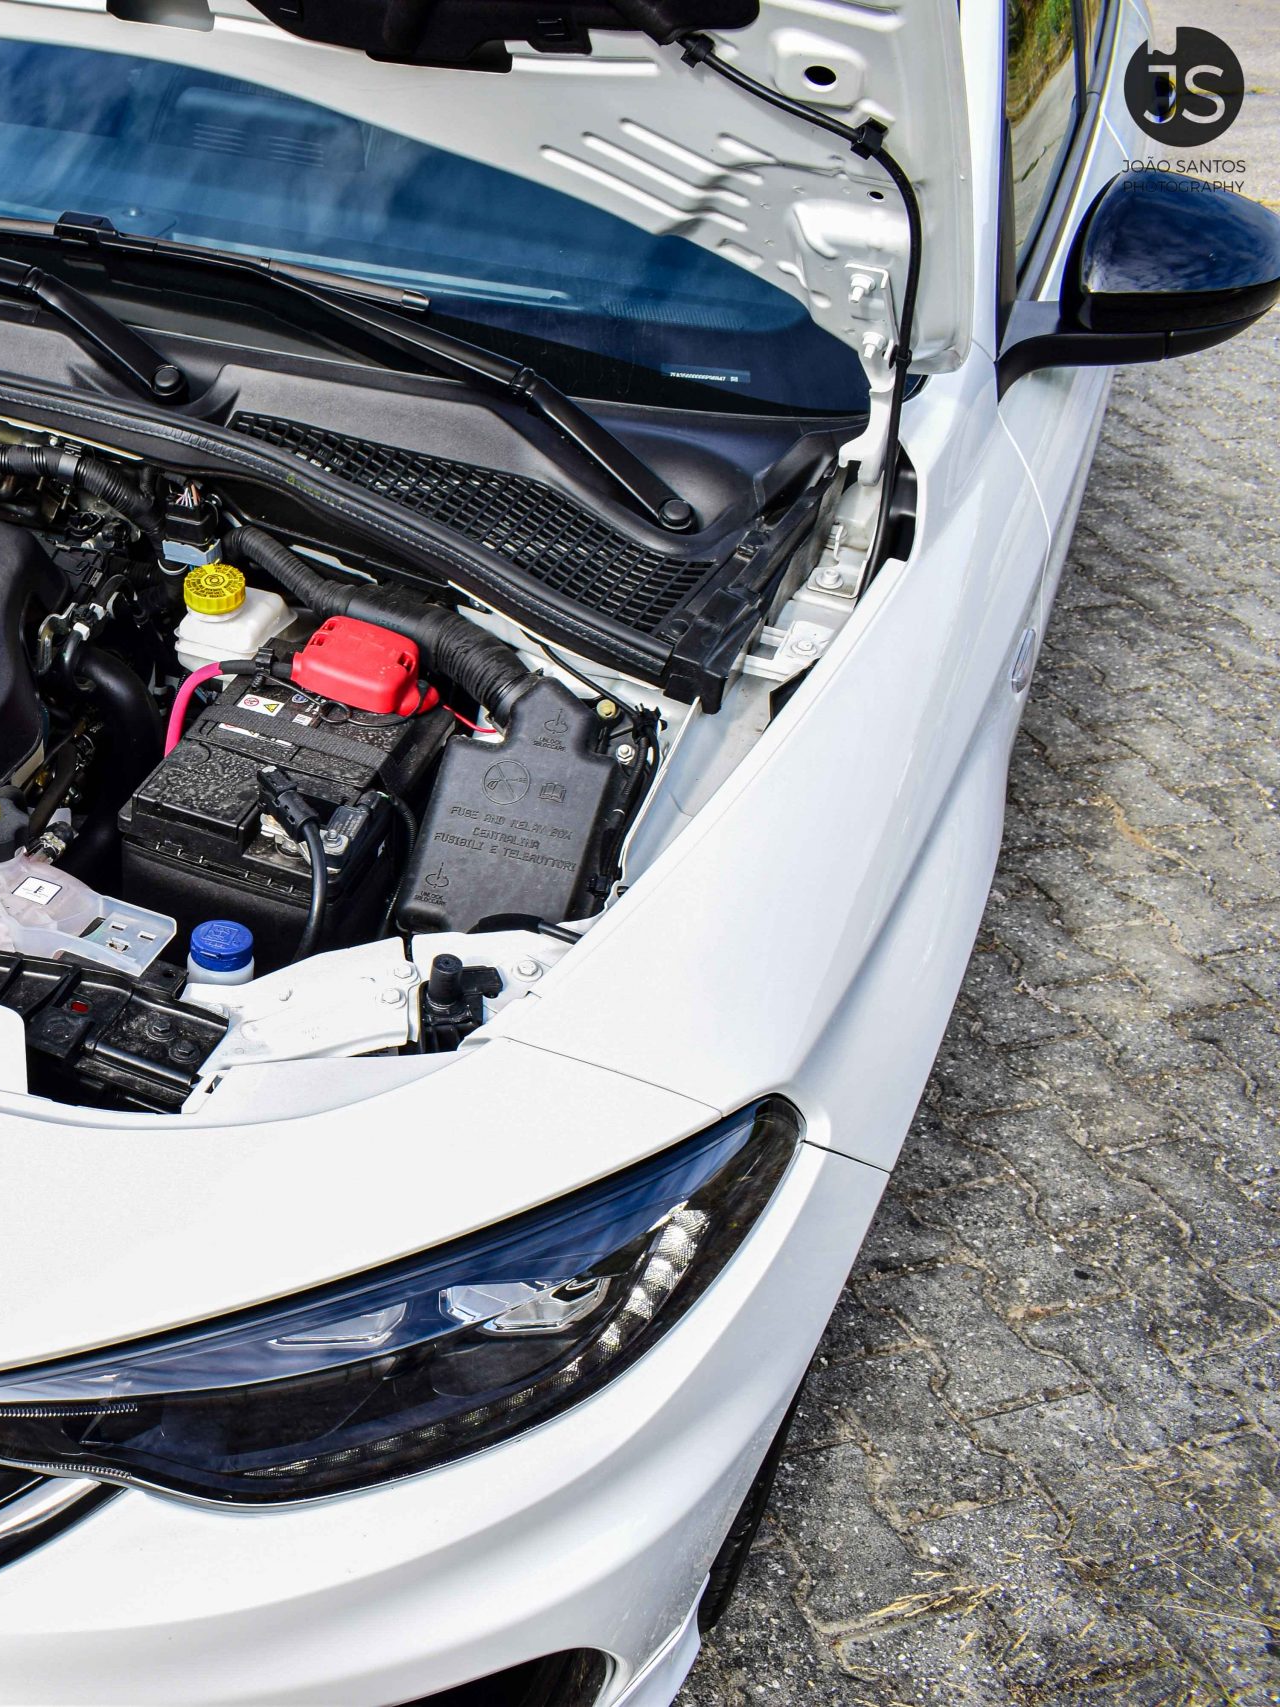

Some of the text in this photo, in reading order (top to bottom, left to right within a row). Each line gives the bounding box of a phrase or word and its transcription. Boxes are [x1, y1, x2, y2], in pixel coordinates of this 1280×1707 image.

[450, 806, 573, 841] FUSE AND RELAY BOX
[472, 826, 541, 850] CENTRALINA
[433, 832, 577, 873] FUSIBILI E TELERUTTORI
